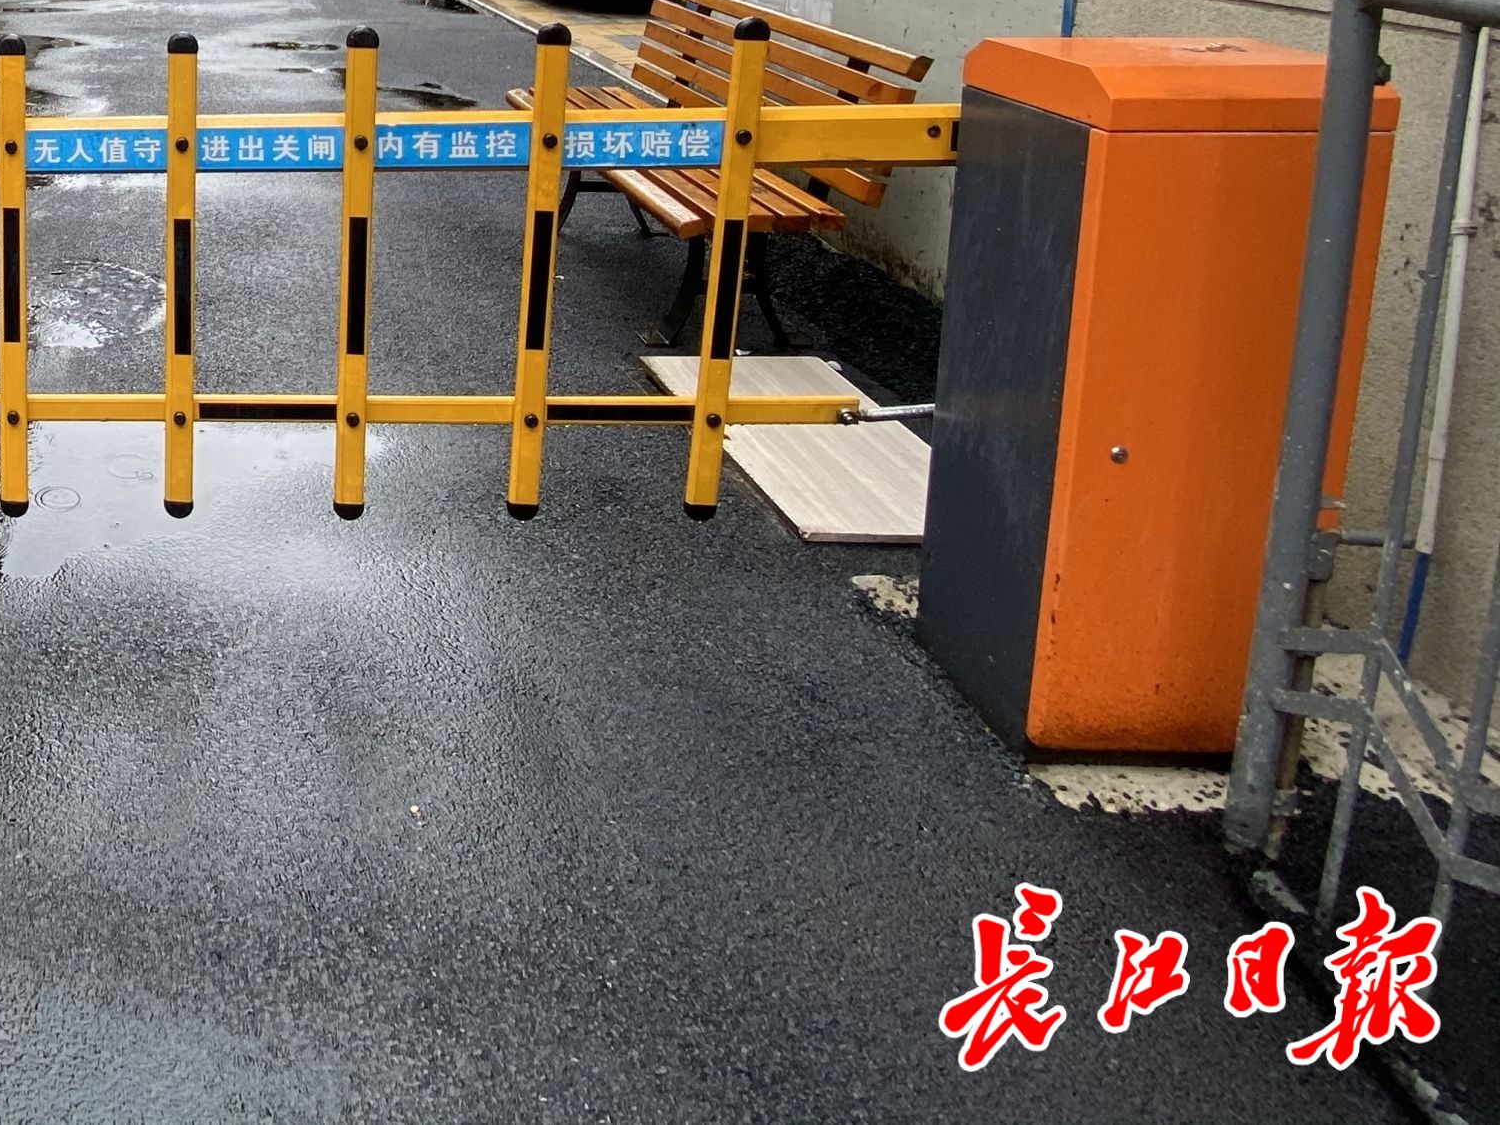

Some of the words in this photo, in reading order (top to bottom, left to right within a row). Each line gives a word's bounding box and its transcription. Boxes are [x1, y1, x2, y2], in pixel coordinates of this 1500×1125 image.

[33, 135, 162, 165] 无人值守
[201, 133, 337, 163] 进出关闸
[377, 129, 518, 160] 内有监控
[564, 128, 711, 159] 损坏赔偿
